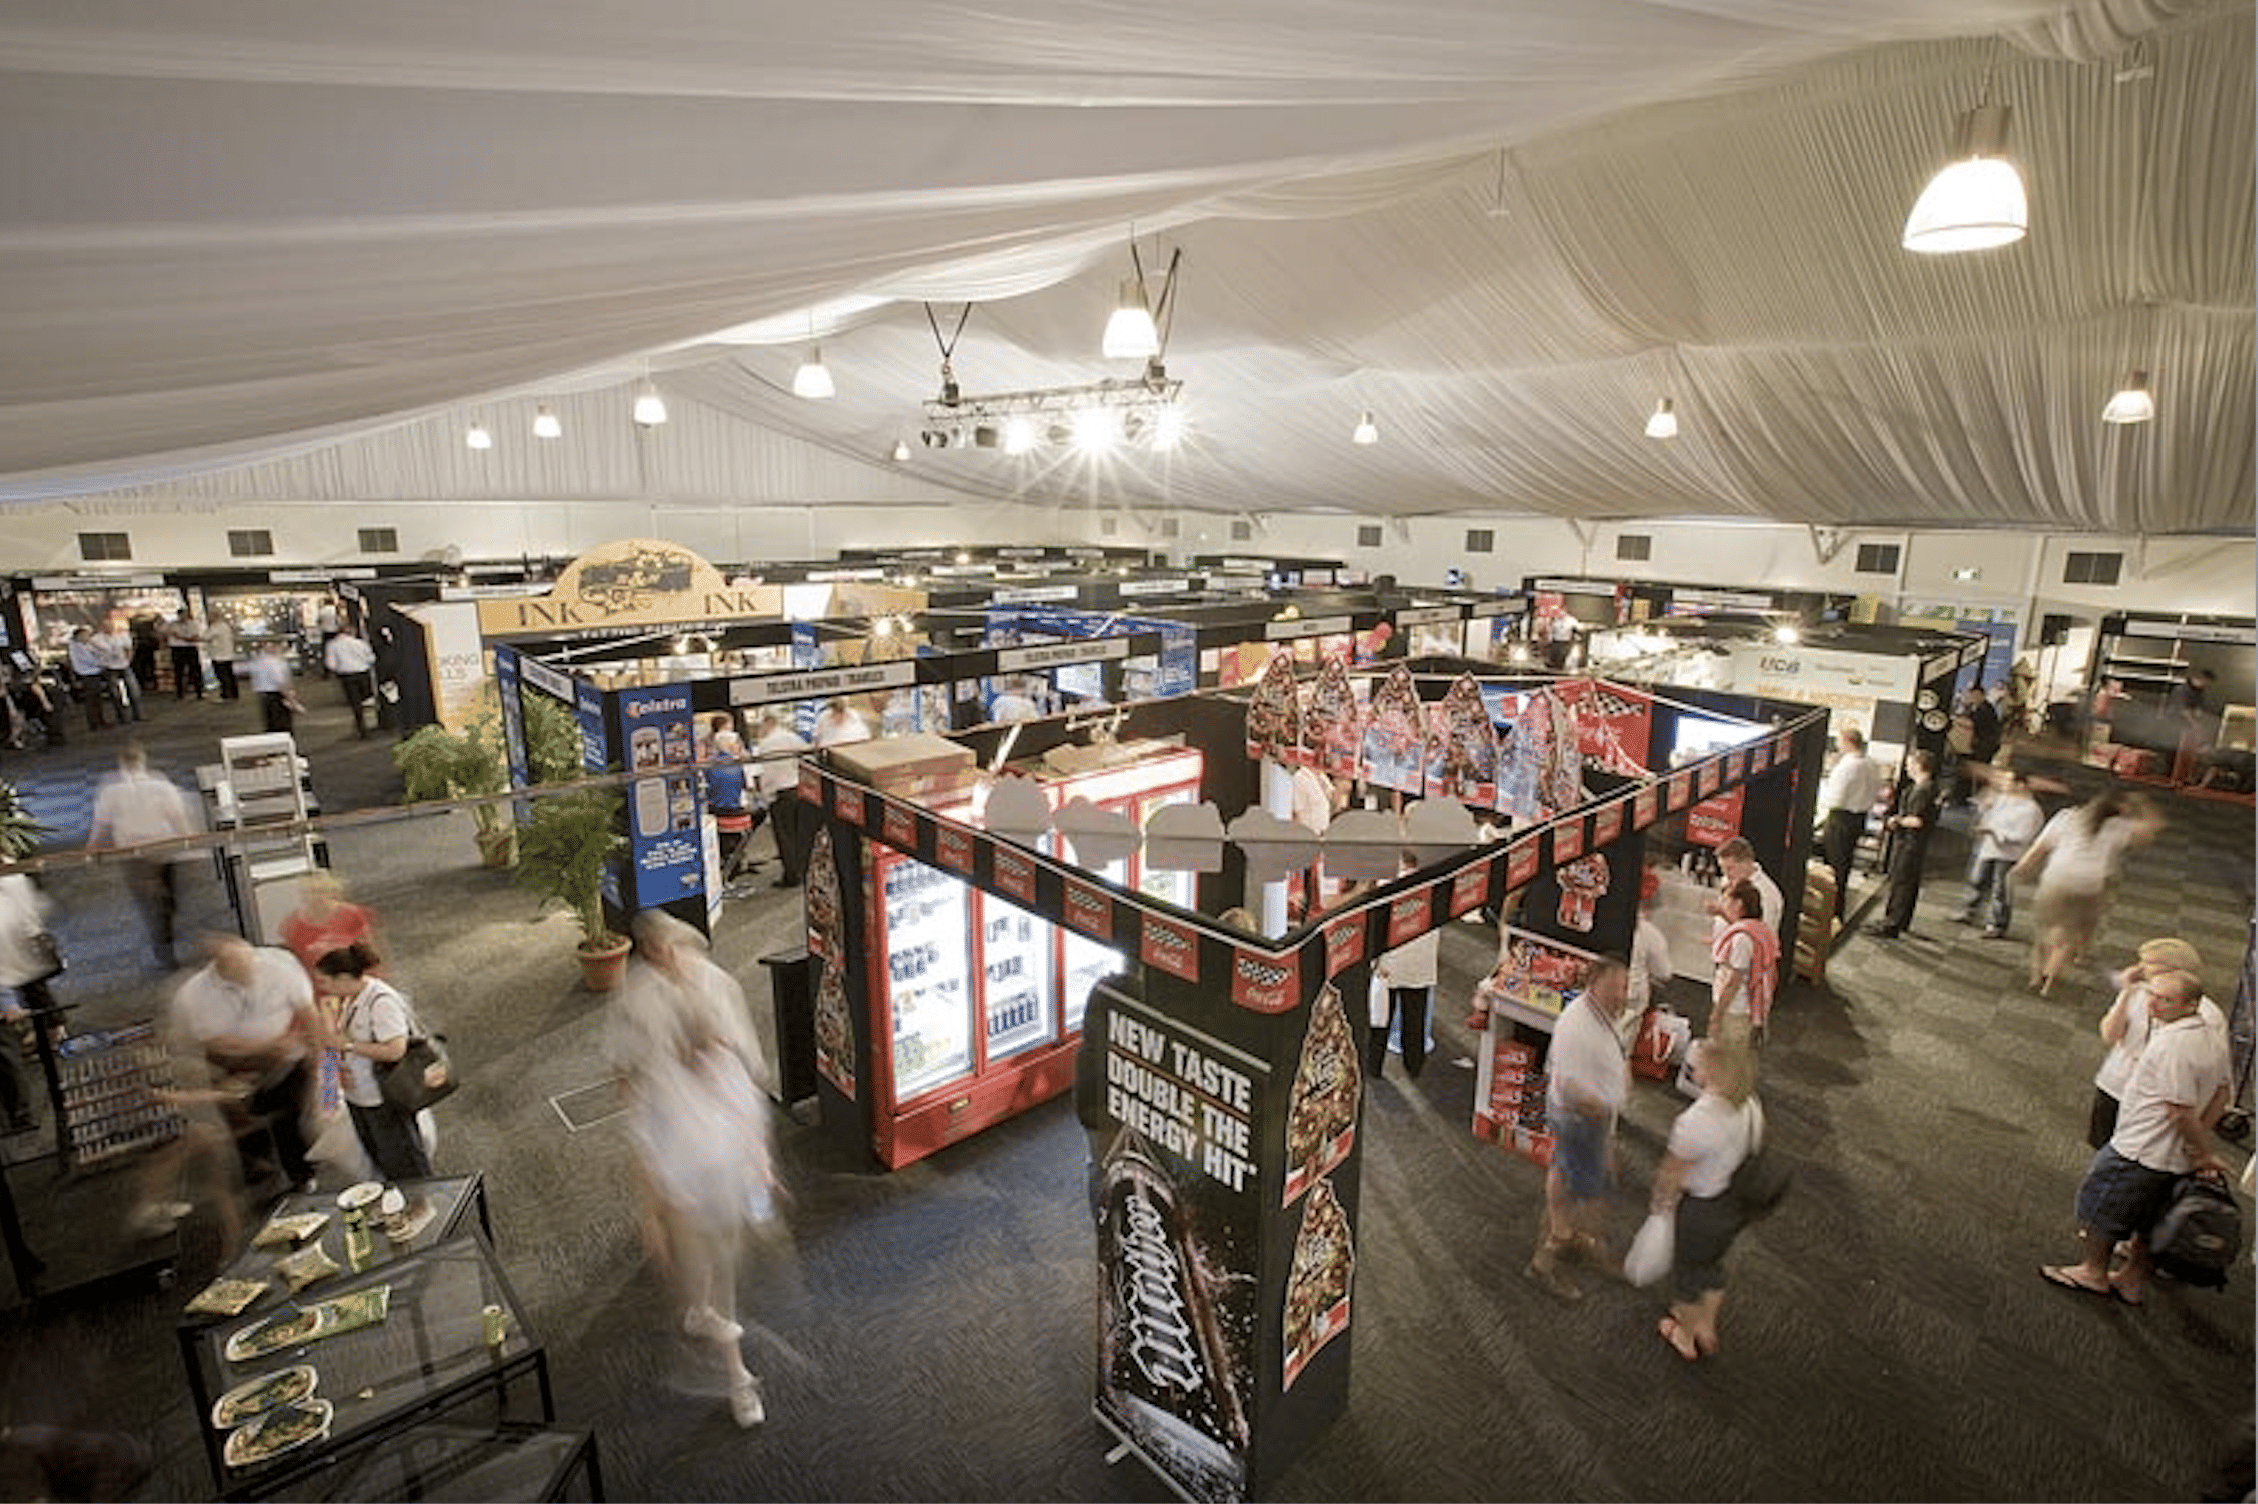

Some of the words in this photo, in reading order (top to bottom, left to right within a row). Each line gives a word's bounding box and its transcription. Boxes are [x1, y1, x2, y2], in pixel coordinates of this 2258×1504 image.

[518, 602, 583, 627] INK
[704, 592, 757, 614] INK
[626, 698, 687, 719] Telstra
[1107, 1008, 1166, 1064] NEW
[1171, 1041, 1252, 1114] TASTE
[1107, 1051, 1195, 1127] DOUBLE
[1201, 1102, 1251, 1159] THE
[1107, 1084, 1198, 1162] ENERGY
